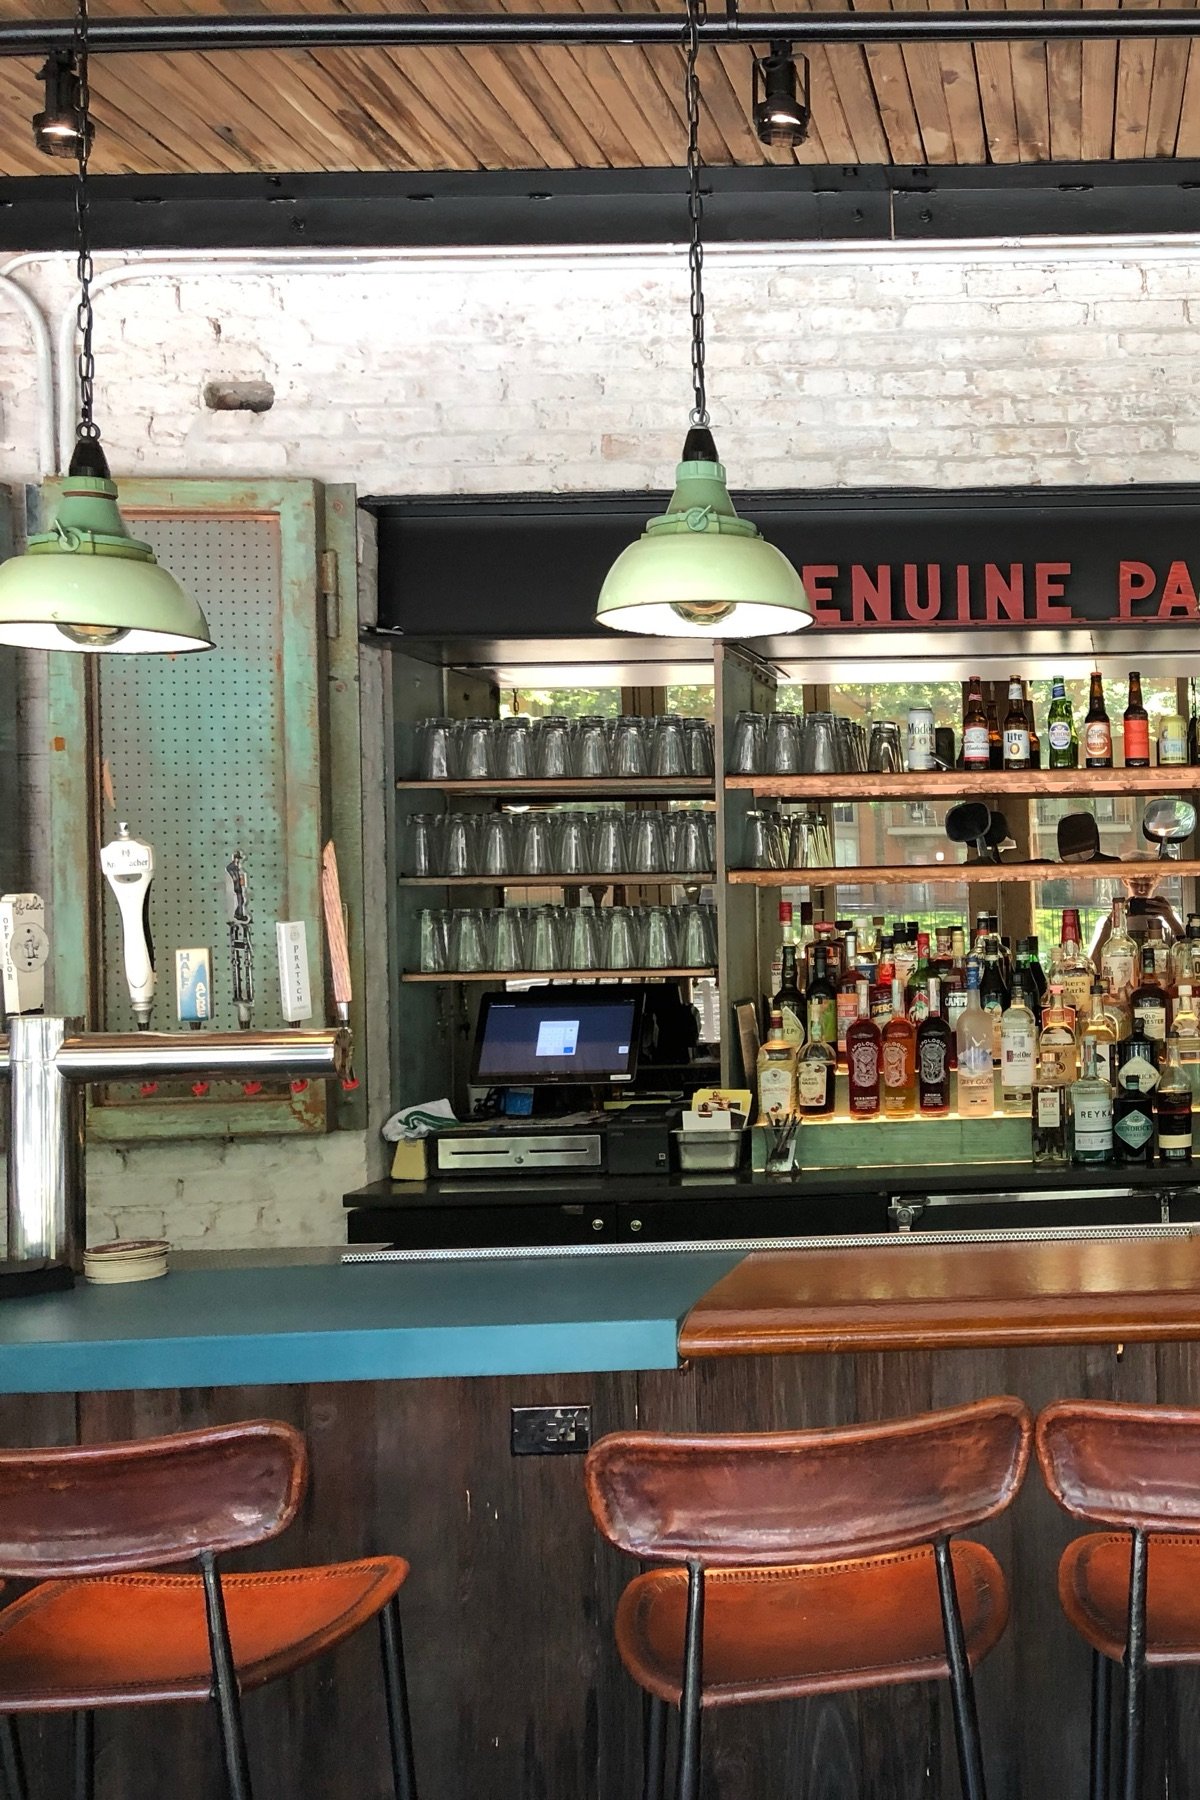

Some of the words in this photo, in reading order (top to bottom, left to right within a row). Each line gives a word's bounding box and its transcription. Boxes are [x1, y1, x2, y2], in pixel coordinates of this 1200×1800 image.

[802, 562, 1072, 622] ENUINE
[1119, 560, 1199, 617] PA
[908, 723, 934, 735] Model
[1007, 731, 1023, 743] Lite
[107, 859, 148, 868] Kracher
[179, 952, 190, 989] HALF
[293, 944, 303, 1003] PRATSCH
[195, 982, 206, 1018] ACRE
[872, 1002, 893, 1015] APERO
[882, 1041, 907, 1053] POLOGUE
[919, 1038, 947, 1049] APOLOGUE
[1080, 1110, 1112, 1119] REYKA
